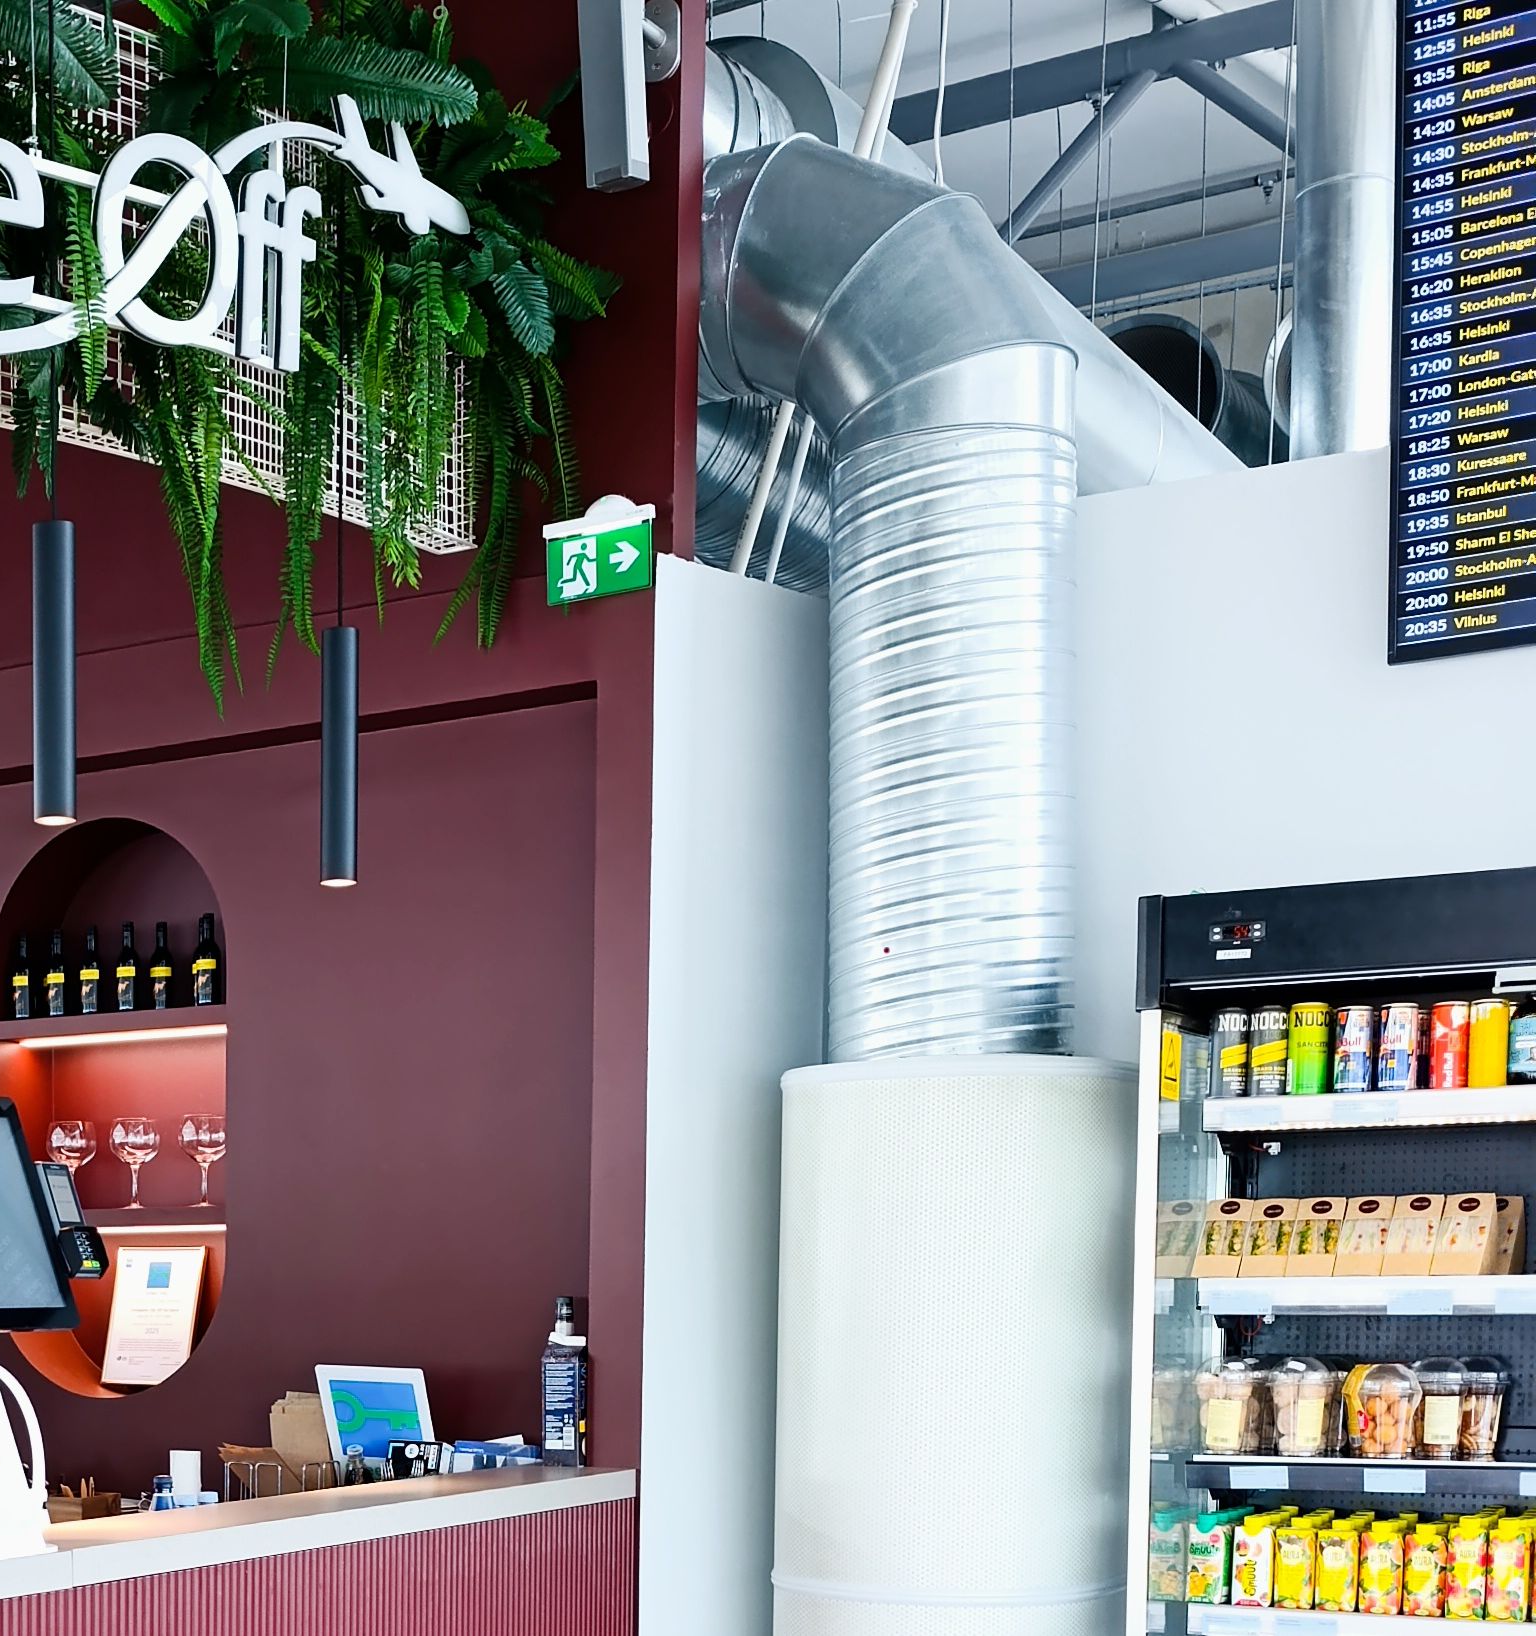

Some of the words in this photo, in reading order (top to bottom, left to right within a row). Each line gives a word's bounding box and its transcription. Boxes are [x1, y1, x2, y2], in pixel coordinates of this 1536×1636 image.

[1414, 11, 1456, 34] 11:55
[1463, 6, 1491, 21] Riga
[1413, 38, 1456, 61] 12:55
[1463, 24, 1515, 48] Helsinki
[1413, 65, 1455, 87] 13:55
[1462, 60, 1491, 75] Riga
[1413, 92, 1455, 114] 14:05
[1413, 119, 1455, 140] 14:20
[1461, 107, 1514, 127] Warsaw
[1412, 145, 1455, 167] 14:30
[1412, 171, 1454, 193] 14:35
[1461, 155, 1536, 181] Frankfurt-M
[1412, 198, 1454, 219] 14:55
[1461, 185, 1512, 208] Helsinki
[1411, 225, 1453, 246] 15:05
[1460, 212, 1524, 235] Barcelona
[96, 131, 323, 371] Off
[1411, 251, 1453, 272] 15:45
[1411, 278, 1453, 298] 16:20
[1460, 266, 1522, 288] Heraklion
[1410, 304, 1452, 325] 16:35
[1410, 331, 1452, 351] 16:35
[1459, 320, 1510, 340] Helsinki
[1409, 357, 1452, 377] 17:00
[1458, 349, 1500, 367] Kardla
[1409, 384, 1452, 403] 17:00
[1409, 410, 1451, 429] 17:20
[1457, 399, 1509, 420] Helsinki
[1408, 436, 1450, 456] 18:25
[1457, 428, 1510, 446] Warsaw
[1408, 462, 1450, 482] 18:30
[1457, 451, 1527, 473] Kuressaare
[1408, 489, 1450, 508] 18:50
[1407, 514, 1449, 534] 19:35
[1456, 505, 1507, 525] Istanbul
[1406, 541, 1449, 559] 19:50
[1455, 536, 1496, 551] Sharm
[1499, 530, 1510, 544] El
[1406, 567, 1448, 586] 20:00
[1405, 593, 1448, 611] 20:00
[1454, 584, 1506, 603] Helsinki
[1405, 619, 1447, 637] 20:35
[1453, 614, 1497, 629] Vilnius
